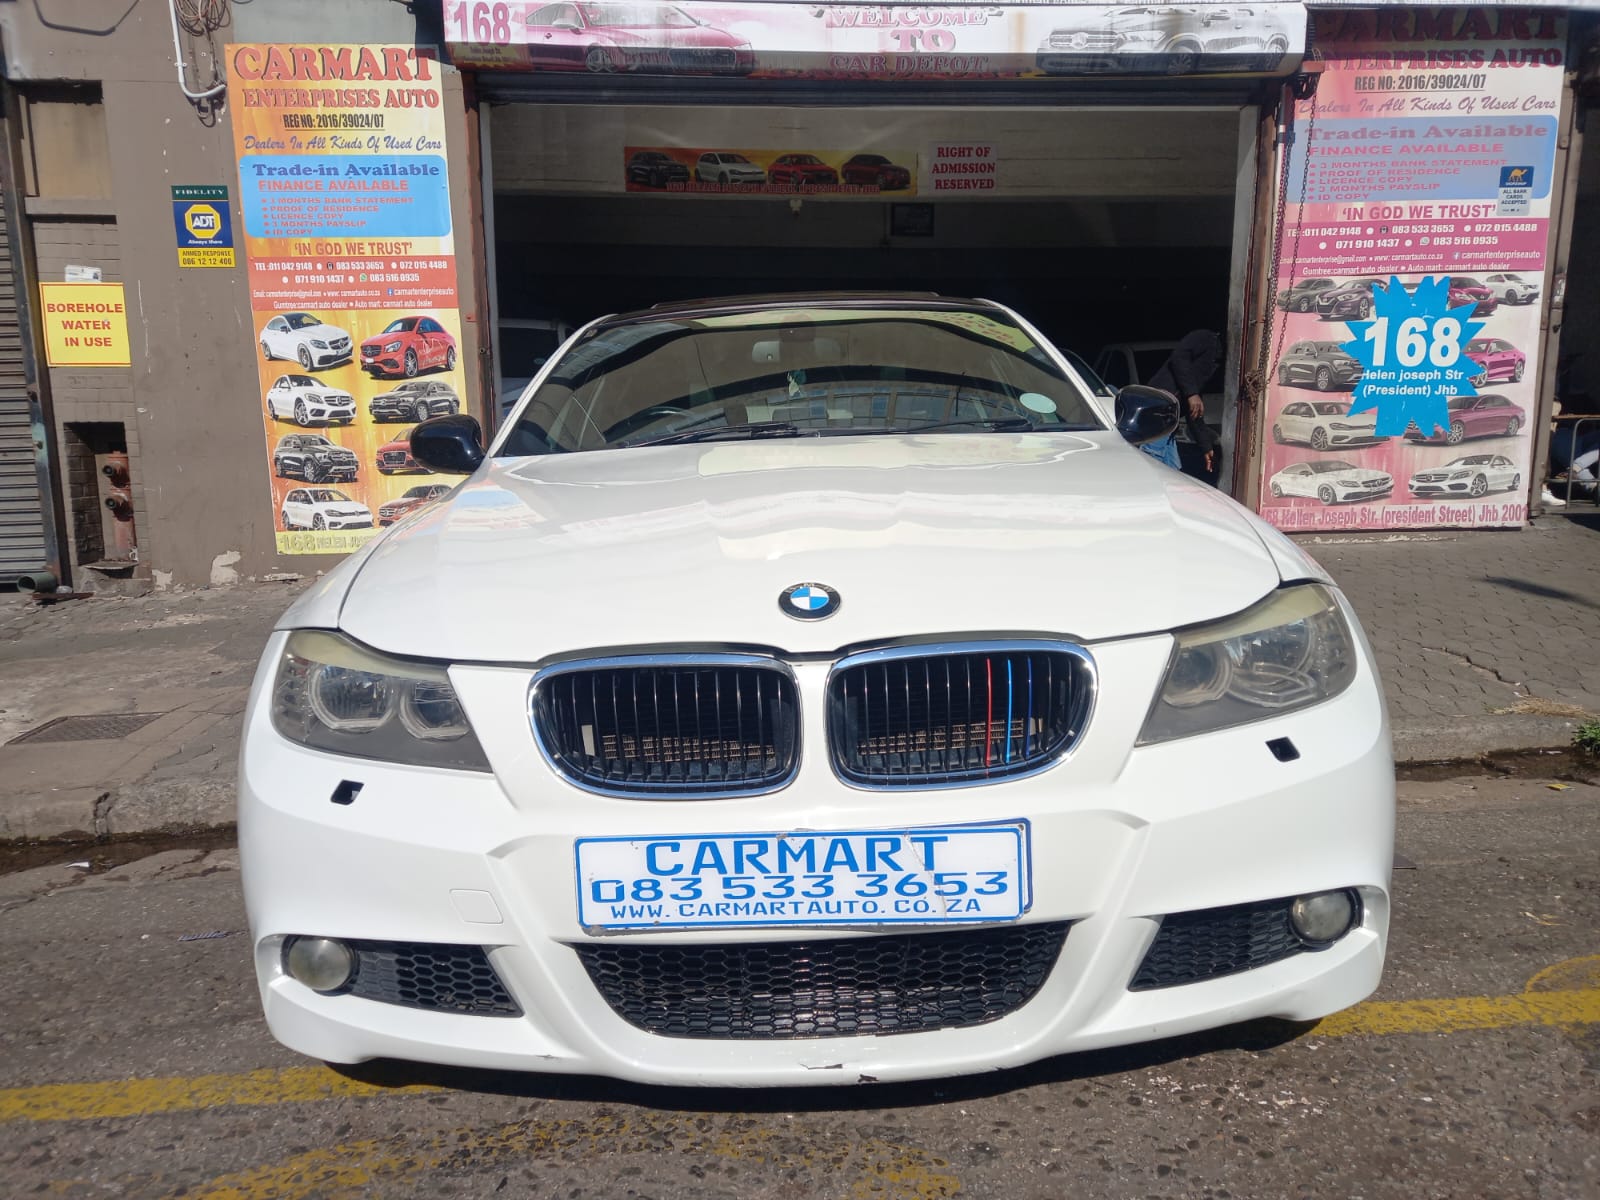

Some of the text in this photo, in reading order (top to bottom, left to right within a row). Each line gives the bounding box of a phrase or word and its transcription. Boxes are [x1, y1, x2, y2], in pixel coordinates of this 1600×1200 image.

[453, 1, 512, 46] 168
[829, 6, 988, 27] WELCOME
[890, 29, 956, 52] TO
[234, 47, 433, 81] CARMART
[829, 54, 988, 73] CAR DEPOT
[1322, 48, 1562, 71] NTERPRISES AUTO
[1354, 74, 1486, 90] REG NO: 2016/39024/07
[242, 88, 439, 109] ENTERPRISES AUTO
[1358, 95, 1556, 114] In All Kinds Of Used Cars
[283, 113, 384, 128] REG NO: 2016/39024/07
[1305, 124, 1548, 140] Trade-in Available
[244, 135, 442, 153] Dealers In All Kinds Of Used Cars
[1308, 143, 1504, 156] FINANCE AVAILABLE
[937, 147, 991, 158] RIGHT OF
[252, 163, 440, 176] Trade-in Available
[932, 163, 996, 174] ADMISSION
[258, 179, 409, 191] FINANCE AVAILABLE
[935, 179, 994, 190] RESERVED
[1389, 183, 1441, 191] PAYSLIP
[1369, 206, 1401, 220] GOD
[1408, 205, 1433, 219] WE
[192, 215, 215, 228] ADT
[1321, 227, 1338, 236] 042
[1340, 226, 1361, 236] 9148
[1392, 225, 1410, 234] 083
[1412, 225, 1429, 234] 533
[1430, 224, 1454, 233] 3653
[1475, 224, 1492, 232] 072
[1513, 223, 1538, 232] 4488
[317, 242, 340, 255] GOD
[344, 242, 365, 255] WE
[1335, 236, 1498, 249] 071 910 1437 083 516 0935
[1361, 265, 1376, 273] auto
[1377, 264, 1398, 273] dealer
[1407, 263, 1424, 271] Auto
[1444, 262, 1471, 270] carmart
[1472, 262, 1488, 270] auto
[1489, 261, 1510, 270] dealer
[47, 304, 123, 313] BOREHOLE
[62, 320, 111, 330] WATER
[64, 337, 112, 347] IN USE
[1364, 317, 1461, 367] 168
[1399, 369, 1441, 382] joseph
[1363, 385, 1458, 398] (President) Jhb
[1318, 508, 1357, 528] Joseph
[1360, 507, 1377, 525] Str.
[1381, 506, 1436, 526] (president
[1439, 505, 1475, 527] Street)
[1479, 504, 1499, 522] Jhb
[280, 534, 316, 551] 168
[646, 835, 949, 876] CARMART
[591, 871, 1008, 904] 083 533 3653
